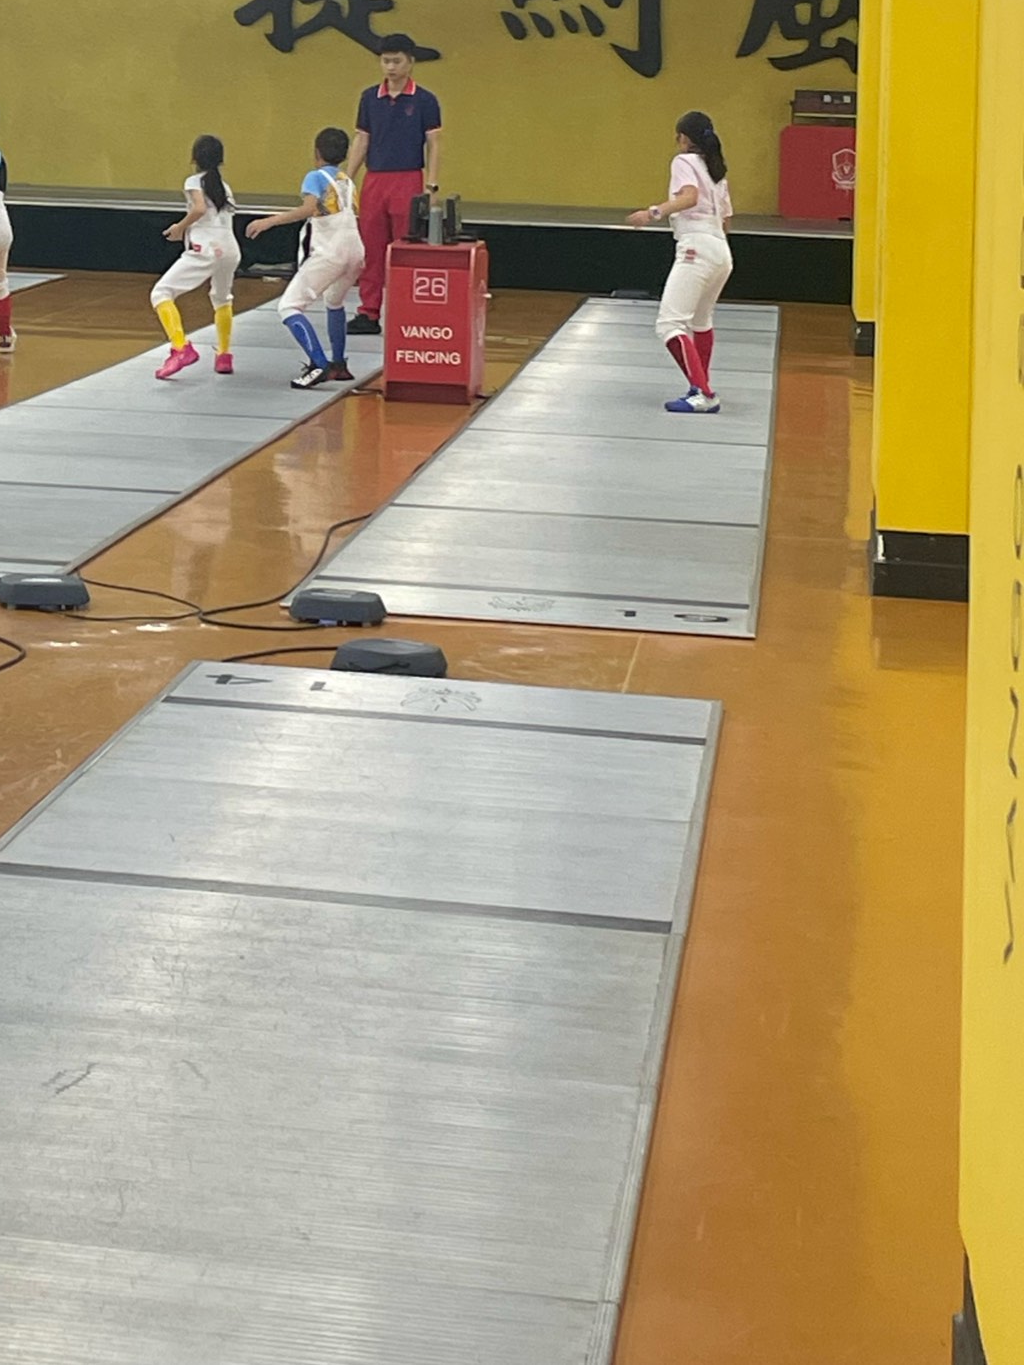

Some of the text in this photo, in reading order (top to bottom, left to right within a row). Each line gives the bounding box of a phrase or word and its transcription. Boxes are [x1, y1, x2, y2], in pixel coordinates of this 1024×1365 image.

[415, 277, 446, 297] 26
[400, 325, 453, 340] VANGO
[396, 350, 461, 365] FENCING
